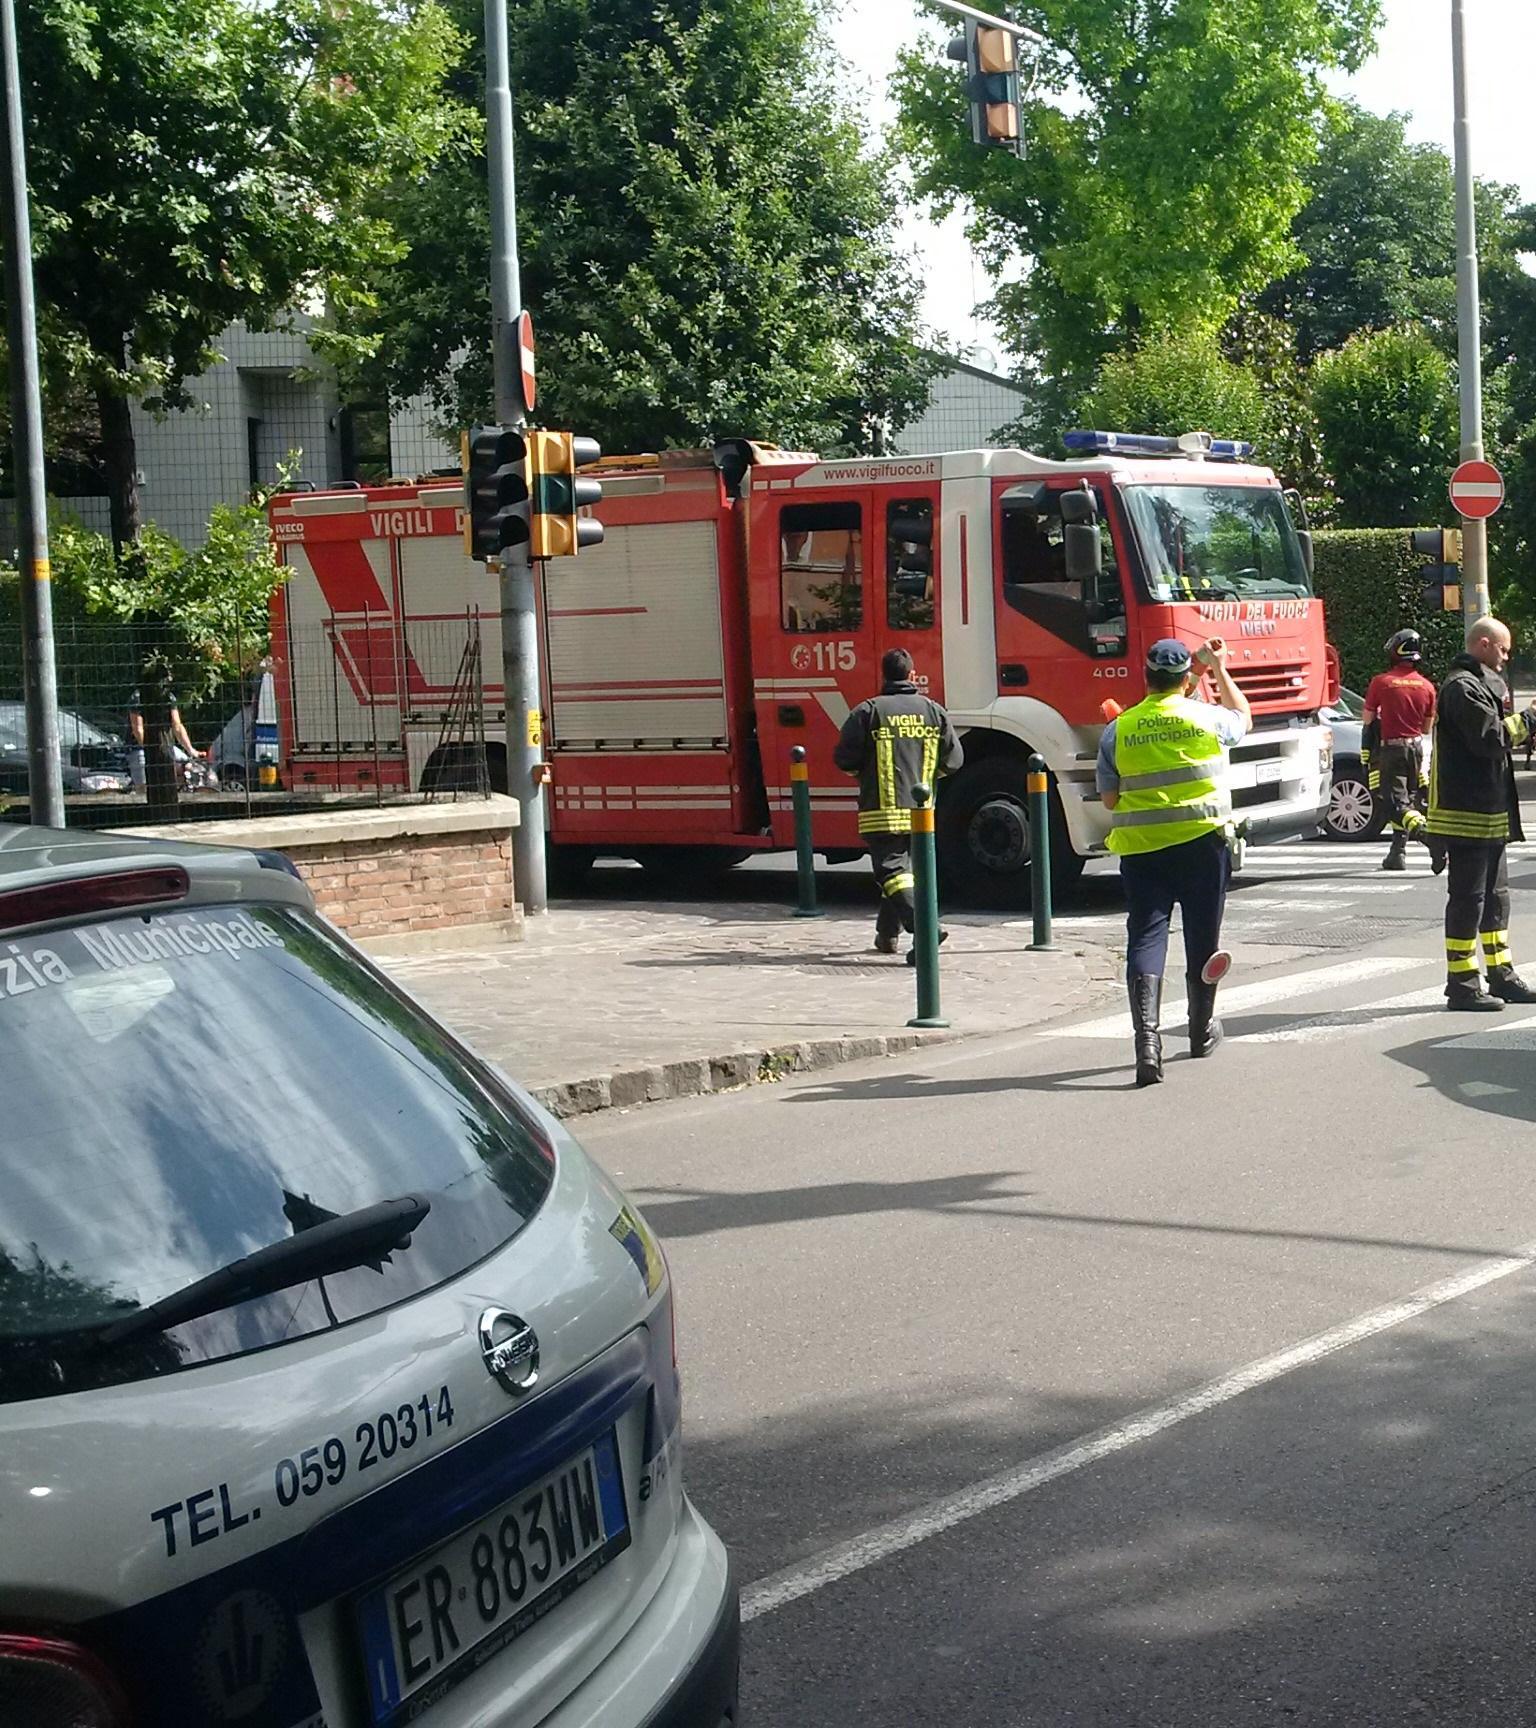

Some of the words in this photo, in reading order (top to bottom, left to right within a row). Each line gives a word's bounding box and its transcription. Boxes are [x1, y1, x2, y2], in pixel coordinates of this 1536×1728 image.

[824, 461, 935, 481] www.vigilfuoco.it
[275, 523, 304, 533] IVECO
[370, 510, 433, 536] VIGILI
[1199, 603, 1240, 622] VIGILI
[1246, 602, 1267, 620] DEL
[1240, 620, 1276, 636] IVECO
[813, 640, 856, 671] 115
[1093, 666, 1128, 678] 400
[887, 714, 925, 726] VIGILI
[1137, 714, 1184, 730] Polizia
[871, 727, 895, 740] DEL
[1124, 724, 1206, 748] Municipale
[0, 944, 76, 999] zia
[72, 913, 286, 971] Municipale
[151, 1483, 262, 1558] TEL.
[275, 1437, 347, 1508] 059
[355, 1384, 455, 1472] 20314
[394, 1563, 461, 1685] ER
[471, 1456, 601, 1623] 883WW
